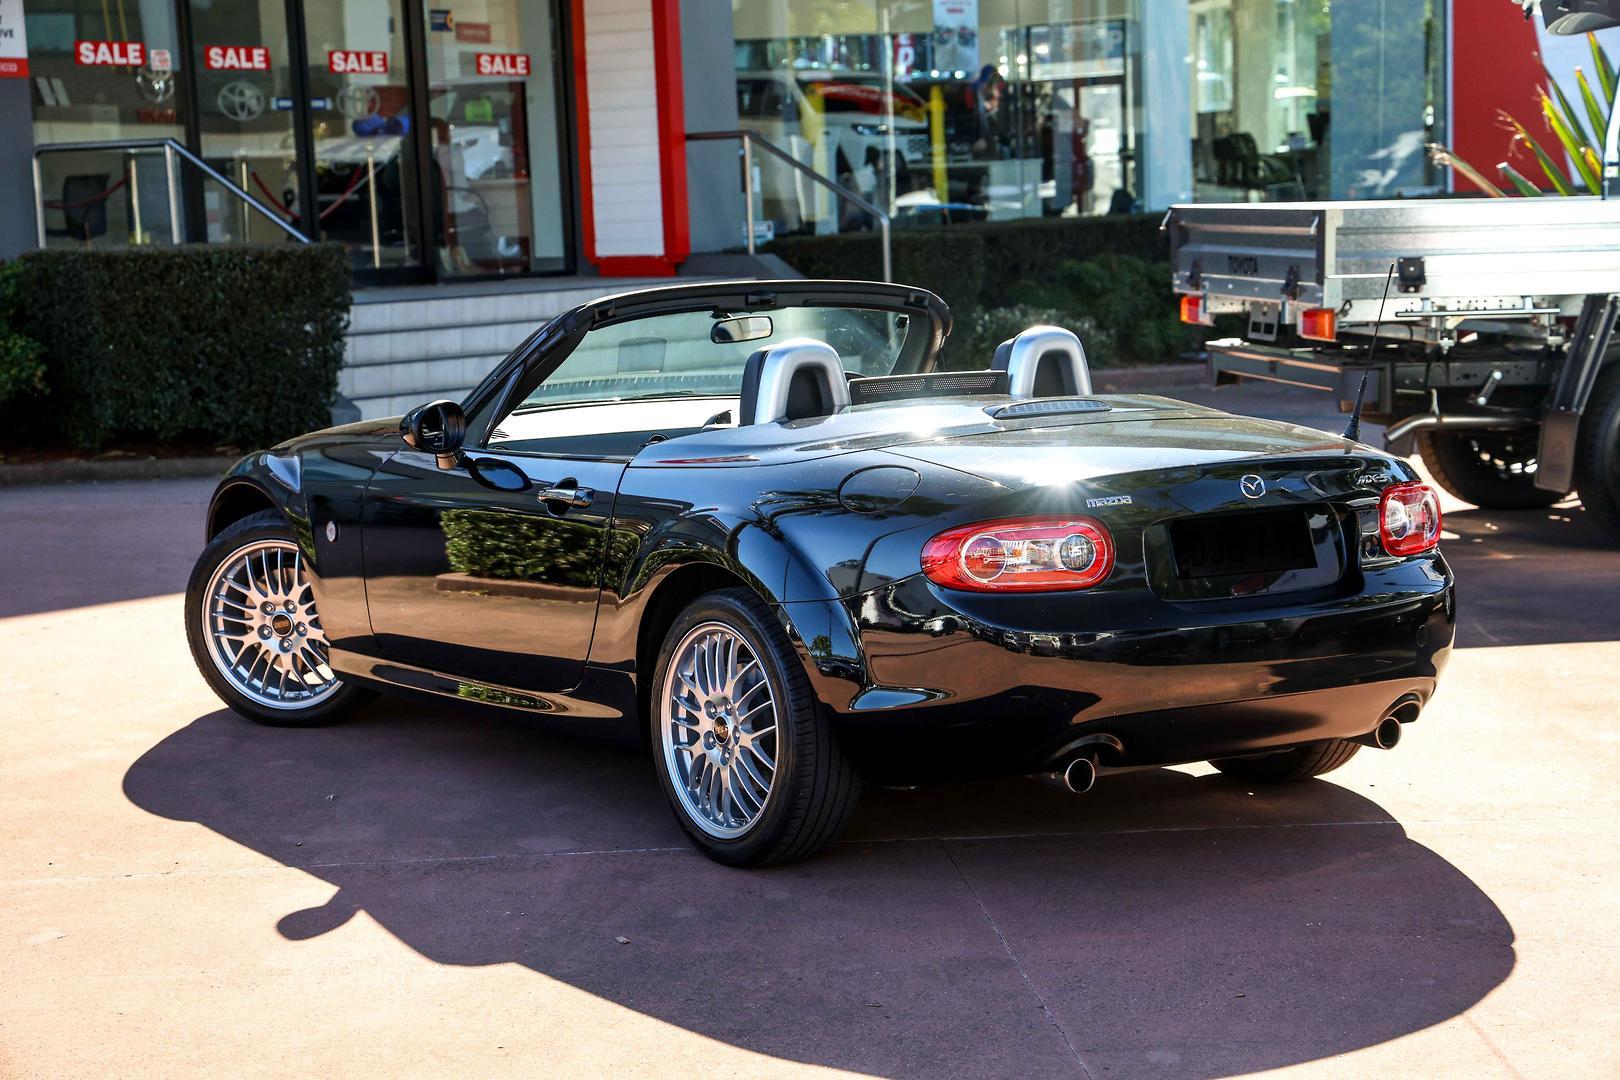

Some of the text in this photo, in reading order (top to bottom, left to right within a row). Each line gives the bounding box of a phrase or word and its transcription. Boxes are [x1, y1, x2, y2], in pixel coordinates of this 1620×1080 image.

[79, 42, 142, 65] SALE
[209, 47, 266, 69] SALE
[331, 53, 385, 73] SALE
[479, 54, 528, 75] SALE
[1227, 255, 1256, 273] TOYOTA
[1357, 472, 1388, 484] MX-5
